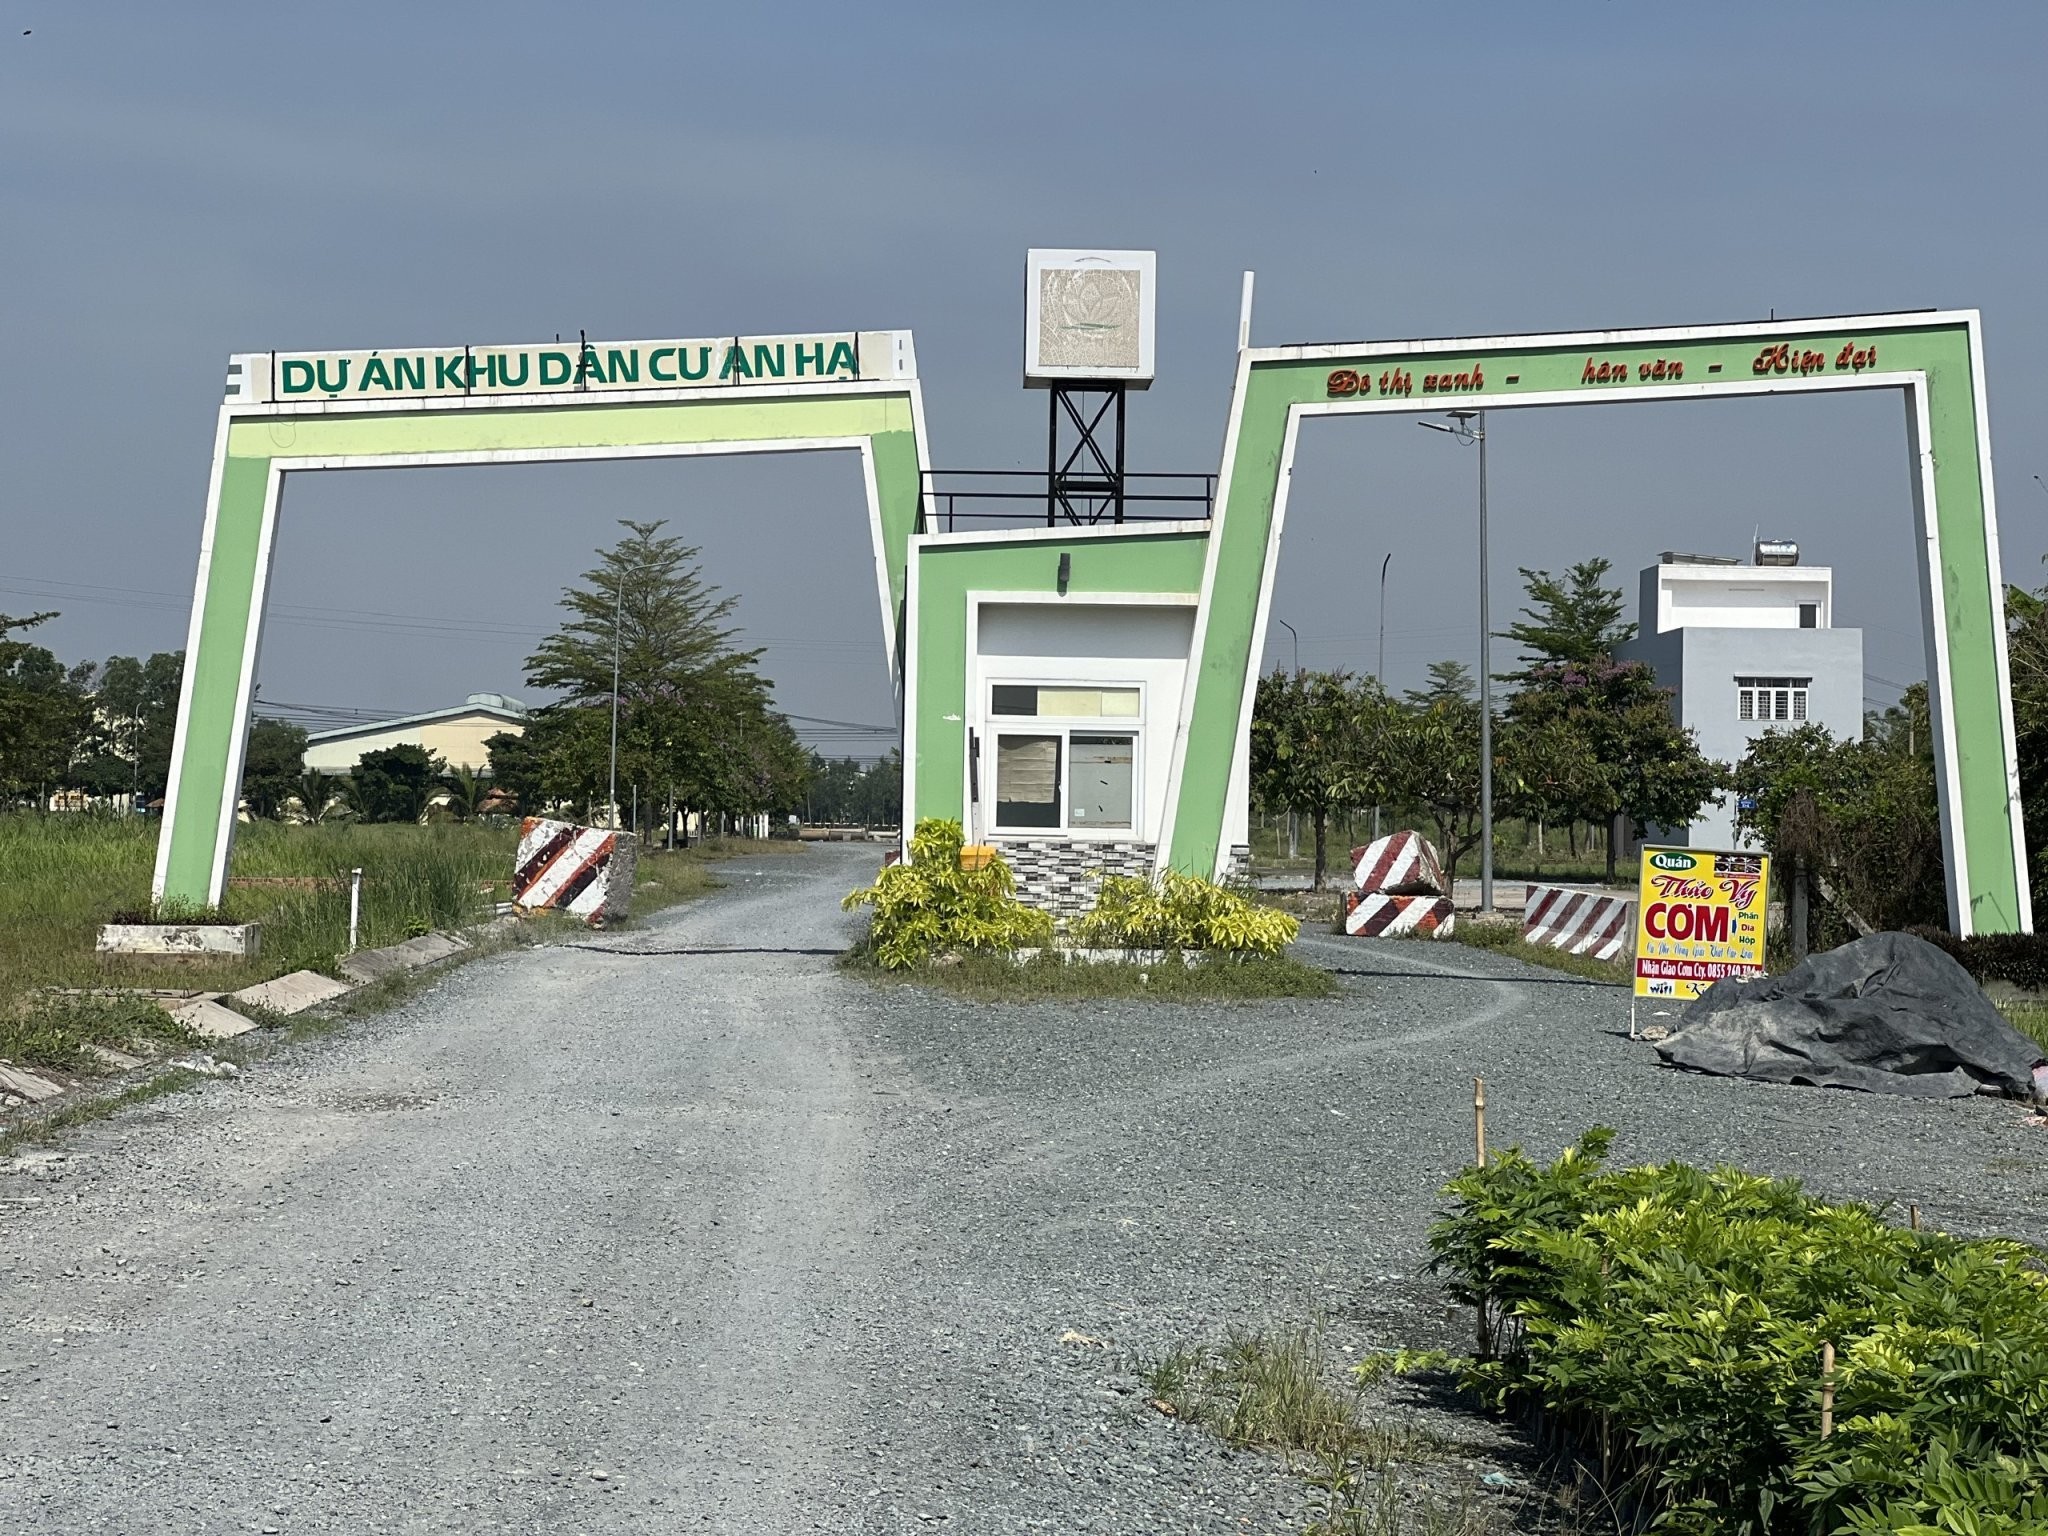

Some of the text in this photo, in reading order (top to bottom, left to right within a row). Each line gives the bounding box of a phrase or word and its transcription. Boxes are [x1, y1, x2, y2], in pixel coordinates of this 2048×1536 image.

[282, 341, 858, 398] DỰ ÁN KHU DÂN CƯ AN HẠ
[1379, 367, 1412, 397] thị
[1423, 363, 1483, 392] xanh
[1638, 359, 1684, 381] văn
[1753, 343, 1825, 377] Hiện
[1835, 341, 1876, 375] đại
[1655, 854, 1691, 868] Quán
[1651, 875, 1759, 910] Thảo Vy
[1645, 902, 1729, 942] CƠM
[1642, 960, 1659, 977] Nhận
[1661, 961, 1676, 975] Giao
